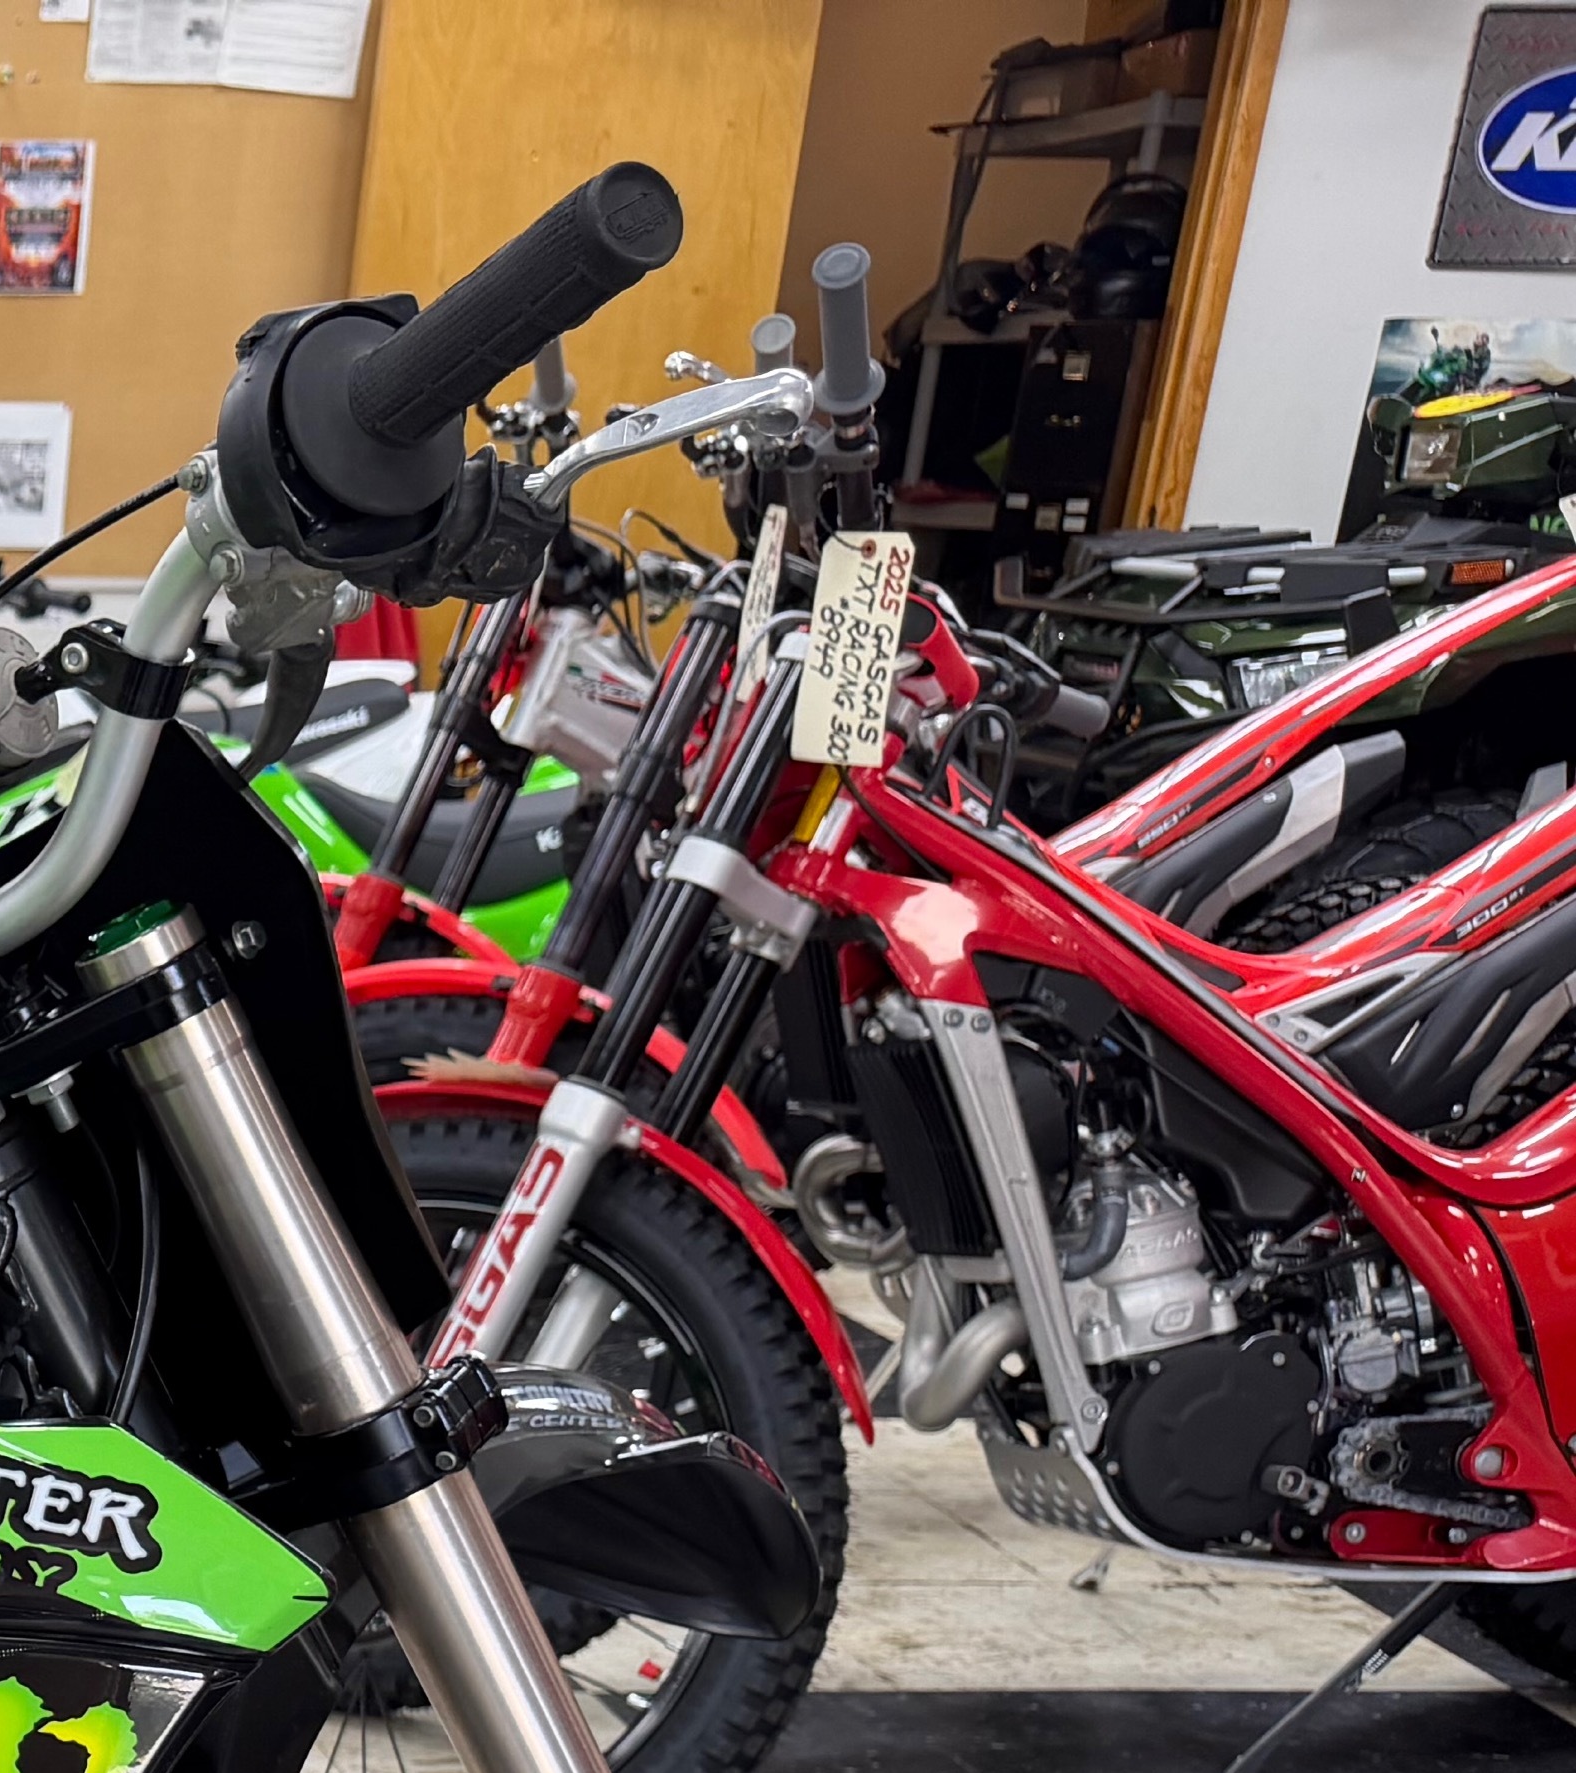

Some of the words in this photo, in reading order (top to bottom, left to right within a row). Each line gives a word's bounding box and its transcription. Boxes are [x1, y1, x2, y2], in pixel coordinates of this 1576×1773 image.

[853, 562, 883, 615] TXT
[880, 546, 910, 616] 2025
[835, 615, 871, 712] RACING
[857, 624, 894, 746] GASGAS
